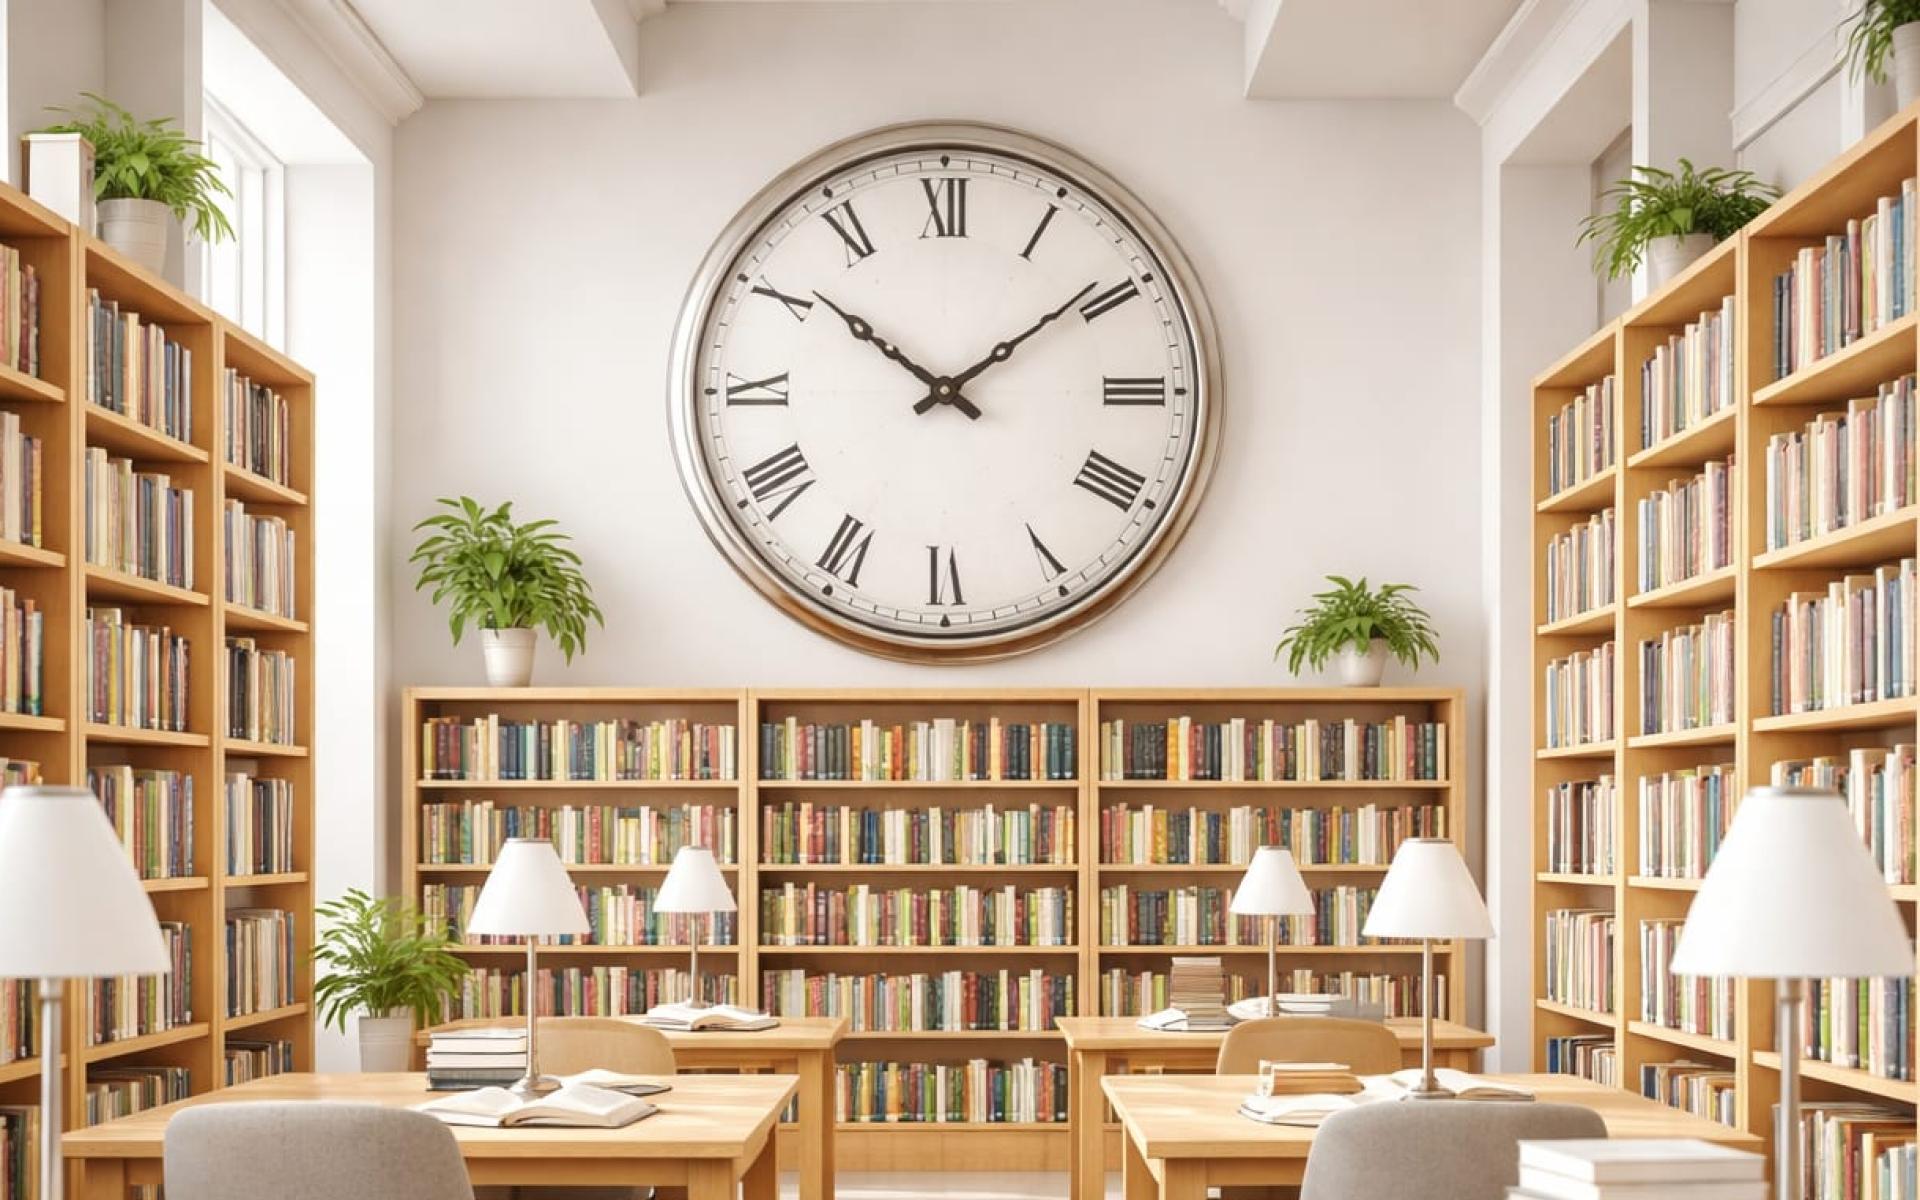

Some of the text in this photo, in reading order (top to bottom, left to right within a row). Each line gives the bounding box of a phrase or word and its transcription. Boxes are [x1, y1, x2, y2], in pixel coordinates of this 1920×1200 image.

[820, 199, 877, 268] XI
[918, 177, 971, 239] XII
[1018, 202, 1060, 262] I
[751, 275, 814, 322] X
[1078, 276, 1141, 324] II
[726, 372, 789, 407] IX
[1102, 375, 1166, 408] III
[742, 442, 816, 523] VIII
[1072, 449, 1147, 513] IIII
[815, 513, 875, 589] VII
[926, 546, 967, 606] VI
[1025, 523, 1068, 583] V
